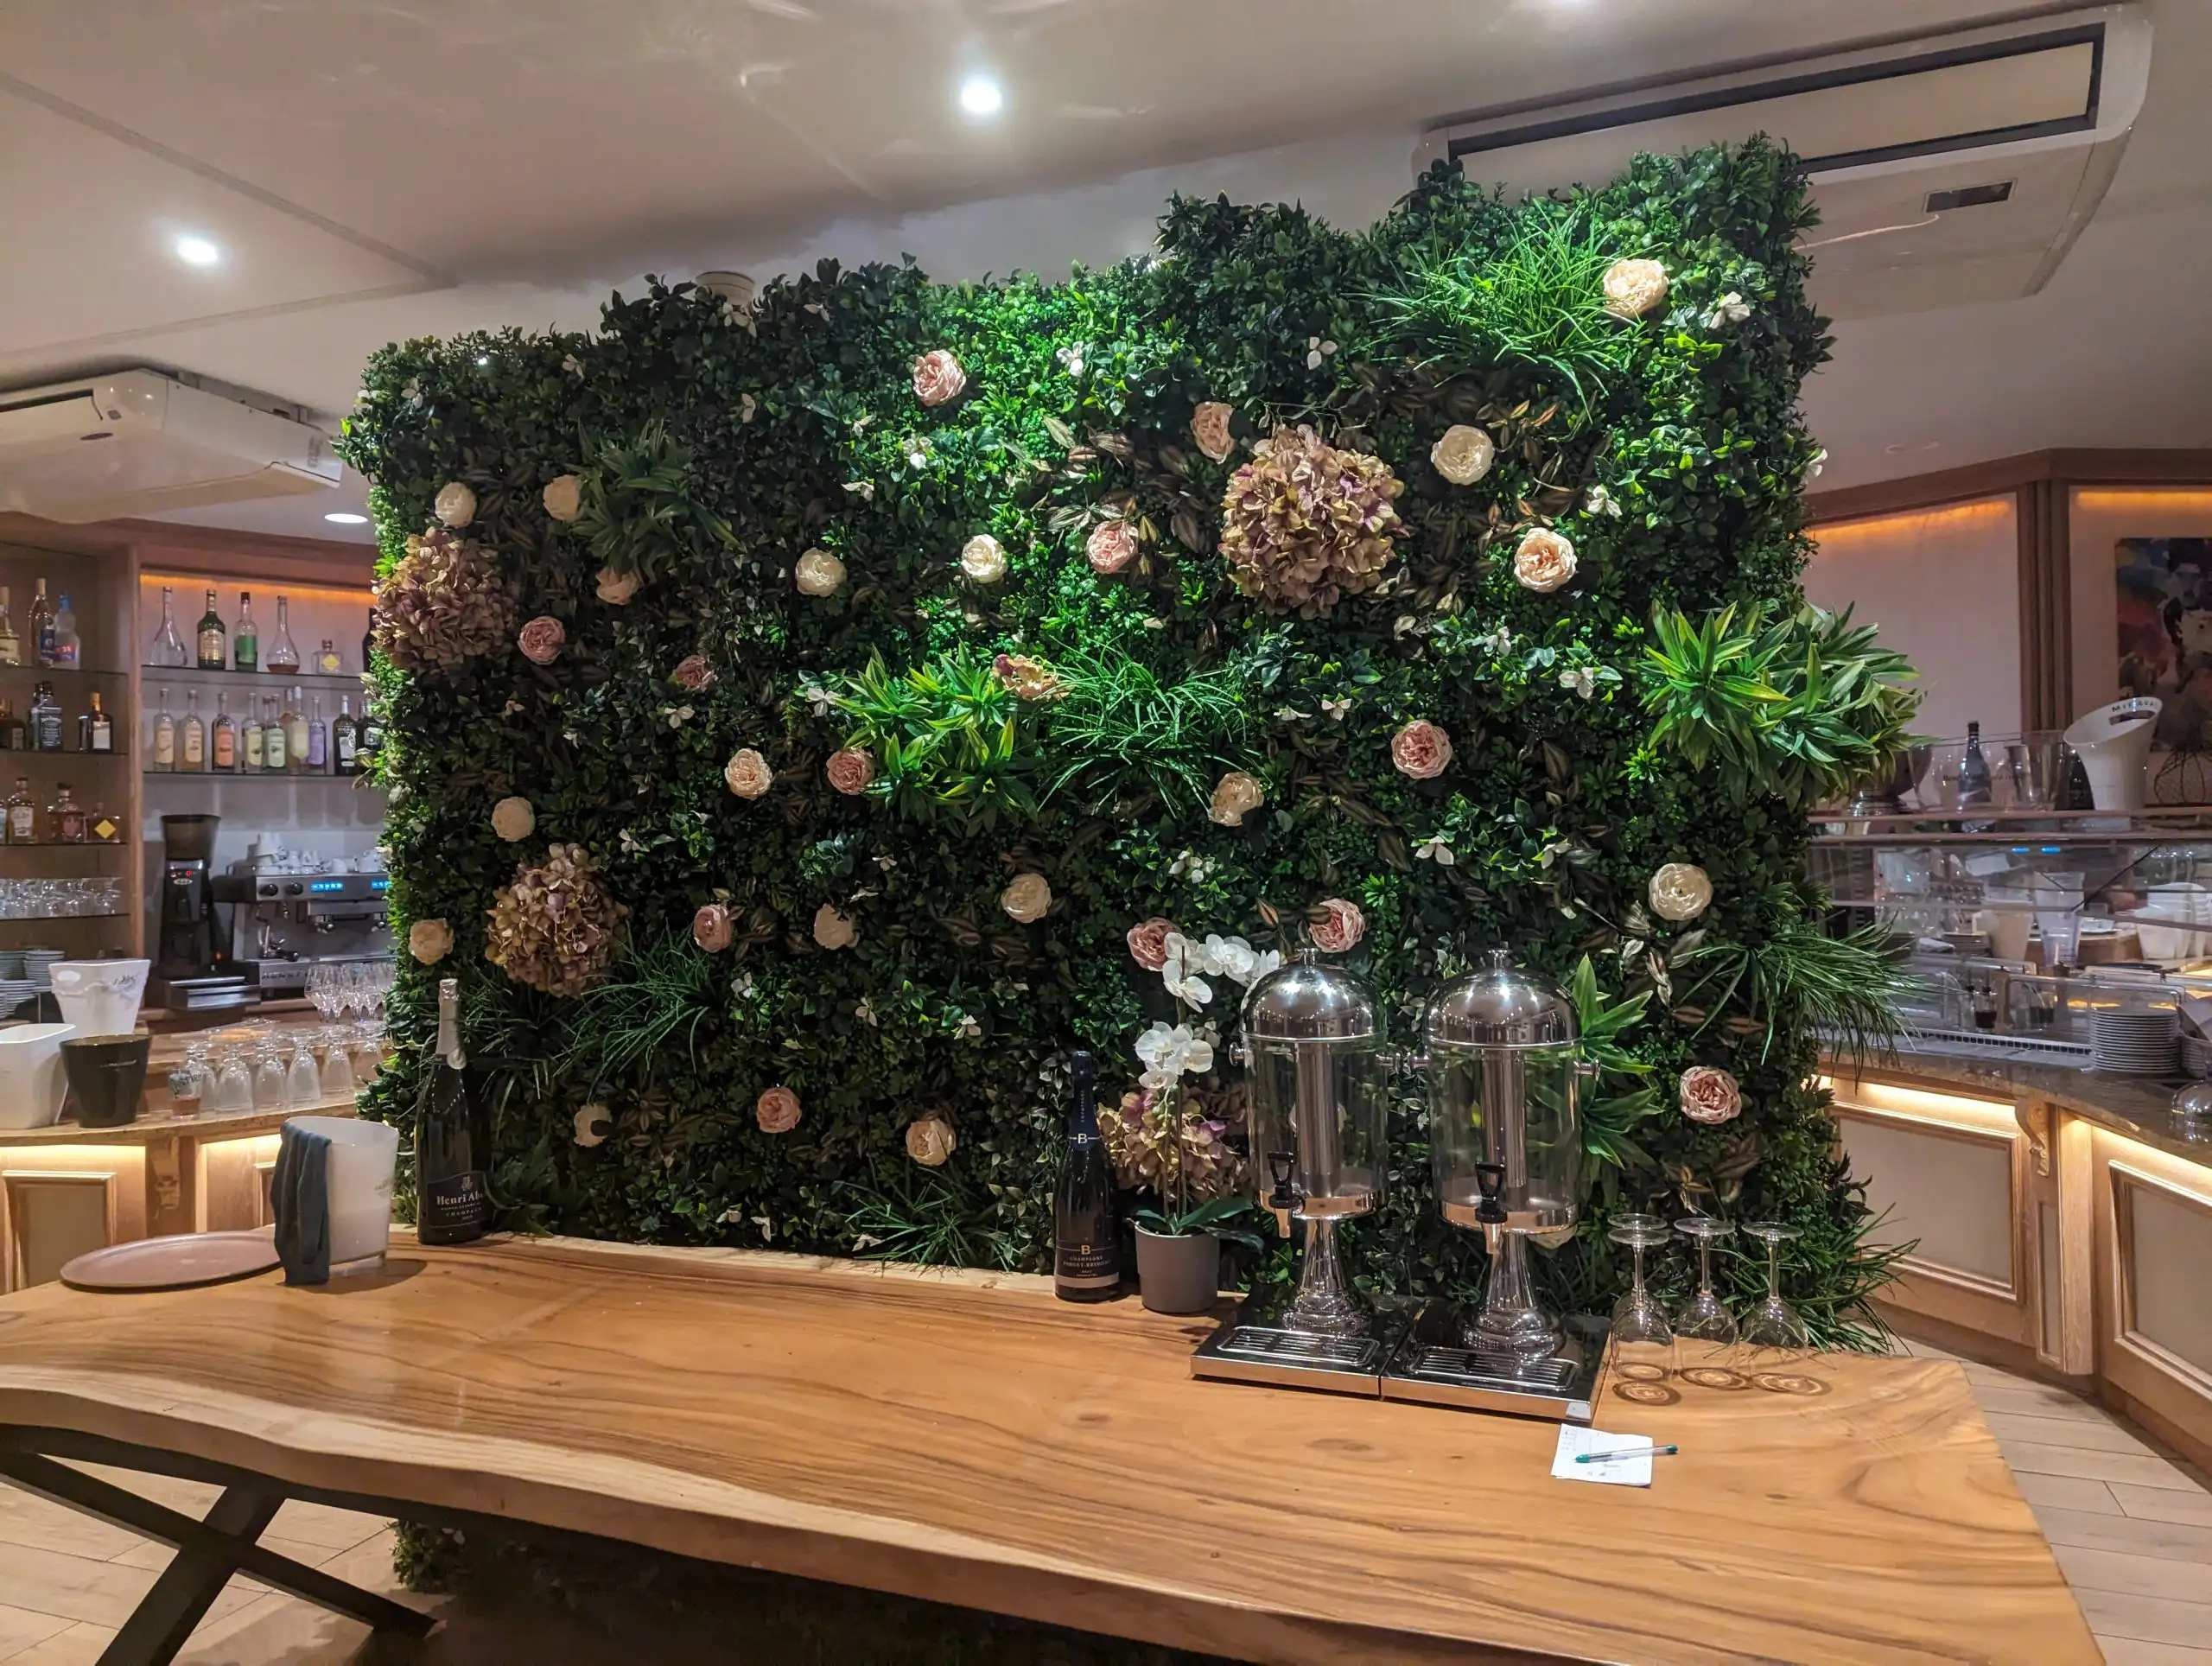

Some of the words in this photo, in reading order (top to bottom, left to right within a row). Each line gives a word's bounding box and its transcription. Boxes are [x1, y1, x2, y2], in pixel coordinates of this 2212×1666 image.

[1077, 1133, 1088, 1144] B
[436, 1193, 467, 1205] Henri
[1081, 1244, 1091, 1255] B
